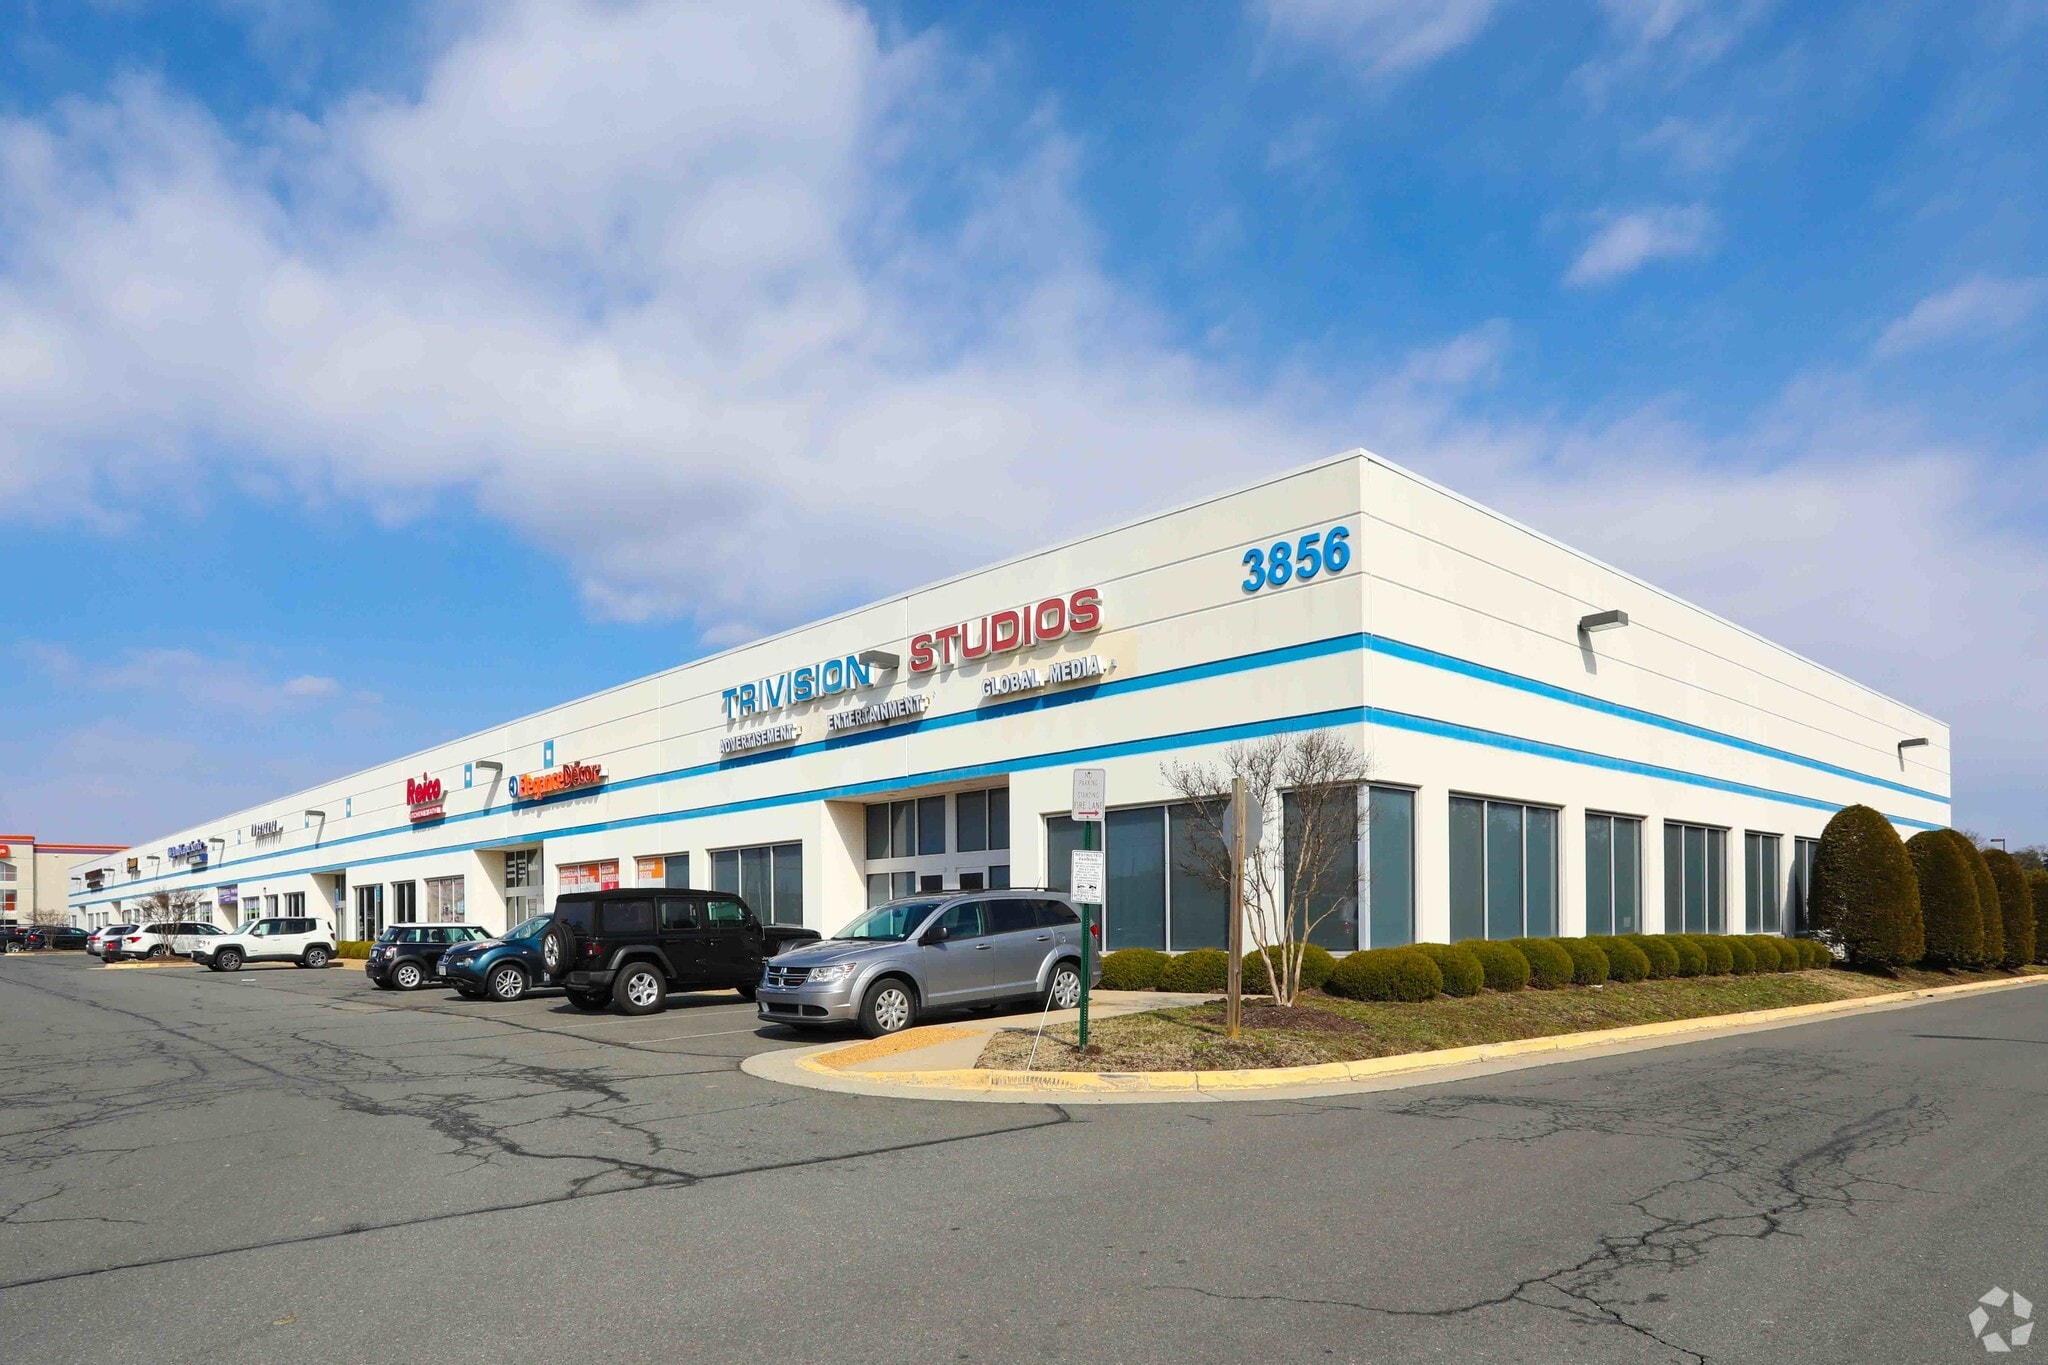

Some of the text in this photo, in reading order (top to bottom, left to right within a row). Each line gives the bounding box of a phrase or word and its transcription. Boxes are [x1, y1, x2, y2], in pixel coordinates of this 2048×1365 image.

[1243, 526, 1350, 592] 3856
[722, 588, 1102, 718] TRIVISION STUDIOS
[719, 655, 1101, 753] ADVERTISEMENT ENTERTAINMENT GLOBAL MEDIA
[407, 772, 441, 805] Reico
[1074, 802, 1103, 810] FIRE LANE
